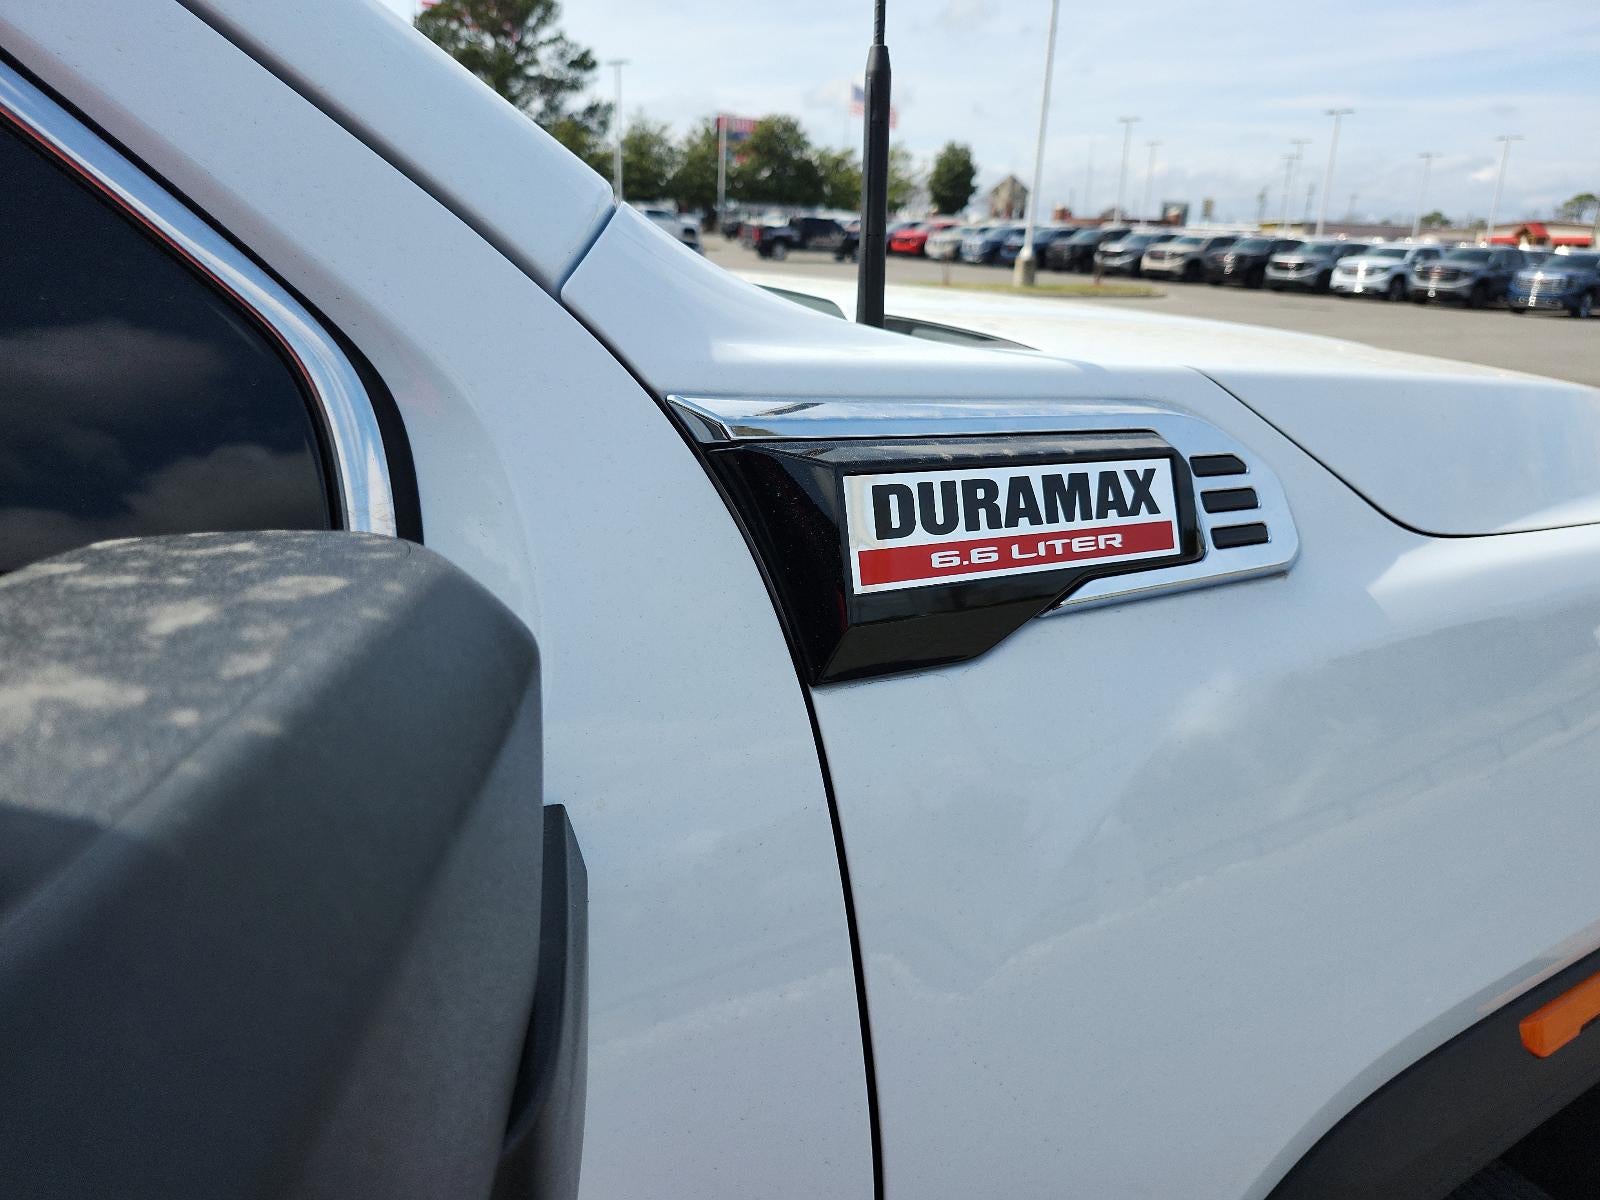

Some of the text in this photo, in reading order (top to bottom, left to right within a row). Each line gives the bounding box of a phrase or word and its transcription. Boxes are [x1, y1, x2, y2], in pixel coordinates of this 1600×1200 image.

[872, 468, 1160, 540] DURAMAX
[930, 533, 1122, 568] 6.6 LITER
